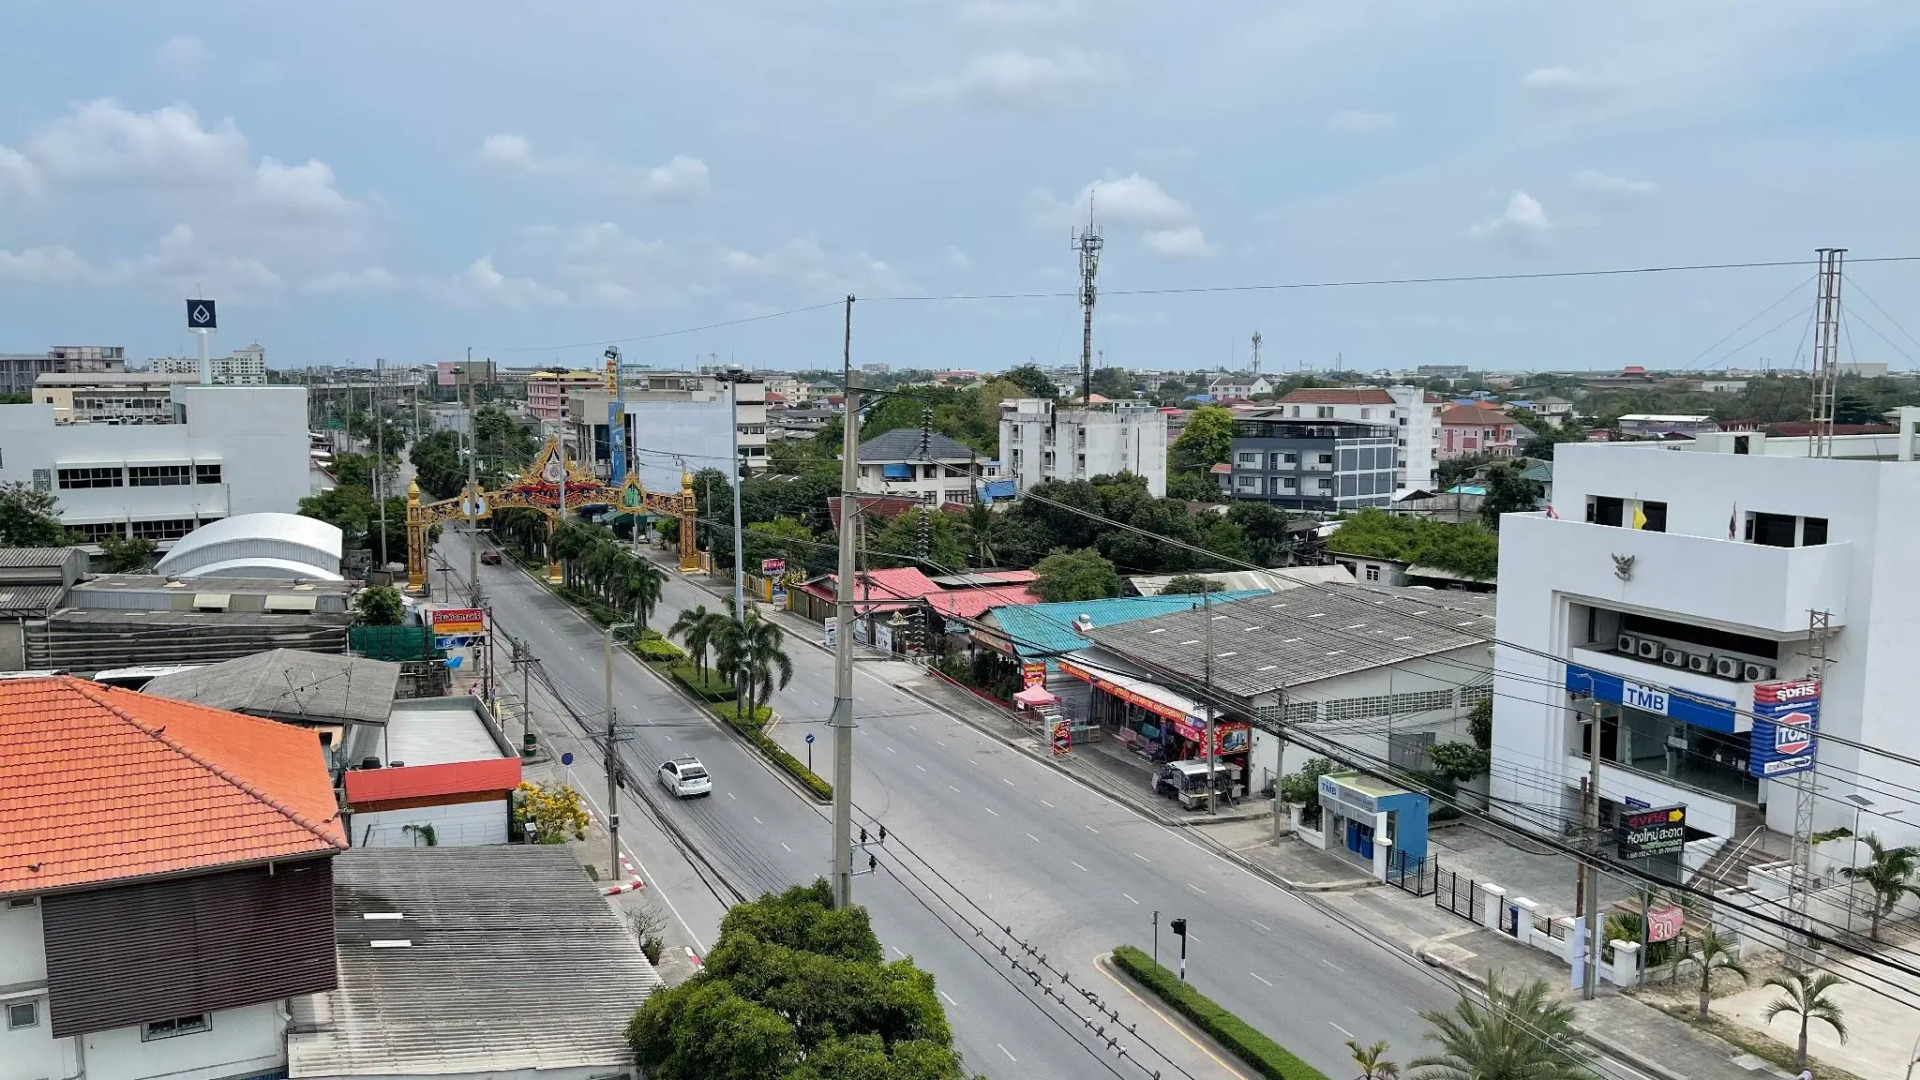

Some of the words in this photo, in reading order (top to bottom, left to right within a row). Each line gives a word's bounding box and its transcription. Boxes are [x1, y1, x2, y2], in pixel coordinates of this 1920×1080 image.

[1627, 688, 1664, 711] TMB
[1779, 724, 1808, 743] TOA
[1321, 782, 1337, 796] TMB
[1627, 827, 1659, 844] ห้องใหม่
[1660, 827, 1683, 840] สะอาด
[1655, 920, 1673, 940] 30
